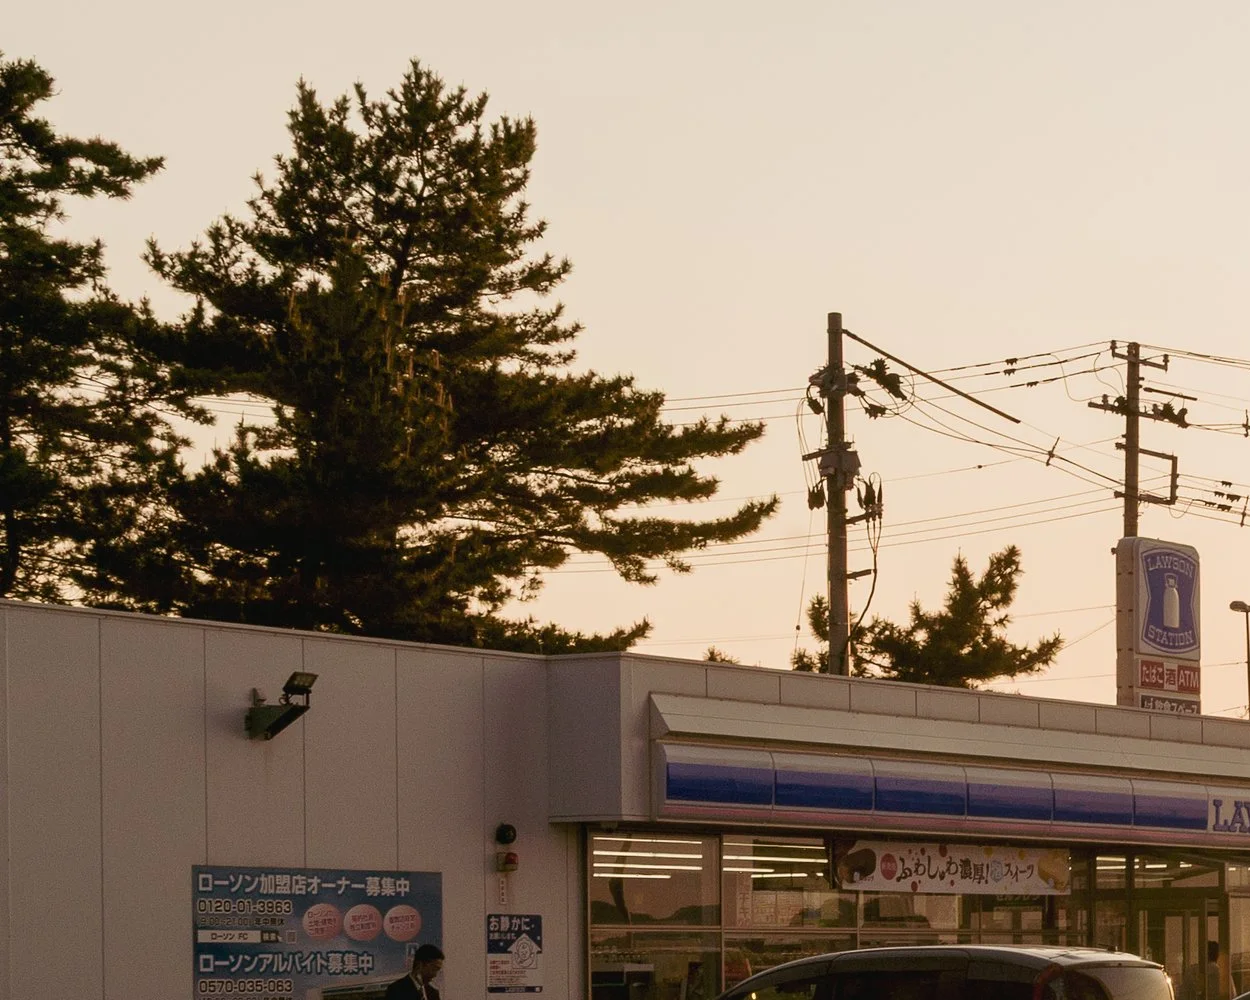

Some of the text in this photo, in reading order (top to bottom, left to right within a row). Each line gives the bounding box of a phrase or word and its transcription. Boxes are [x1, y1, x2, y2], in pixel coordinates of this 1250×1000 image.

[1146, 555, 1194, 578] LAWSON
[1147, 624, 1195, 646] STATION
[1142, 664, 1200, 687] たばこ 酒 ATM
[198, 873, 410, 897] ローソン加盟店オーナー募集中
[198, 899, 292, 914] 0120-01-3963
[489, 915, 530, 931] お静かに
[211, 933, 235, 941] ローソン
[238, 933, 249, 941] FC
[199, 953, 373, 974] ローソンアルバイト募集中
[199, 980, 293, 994] 0570-035-063
